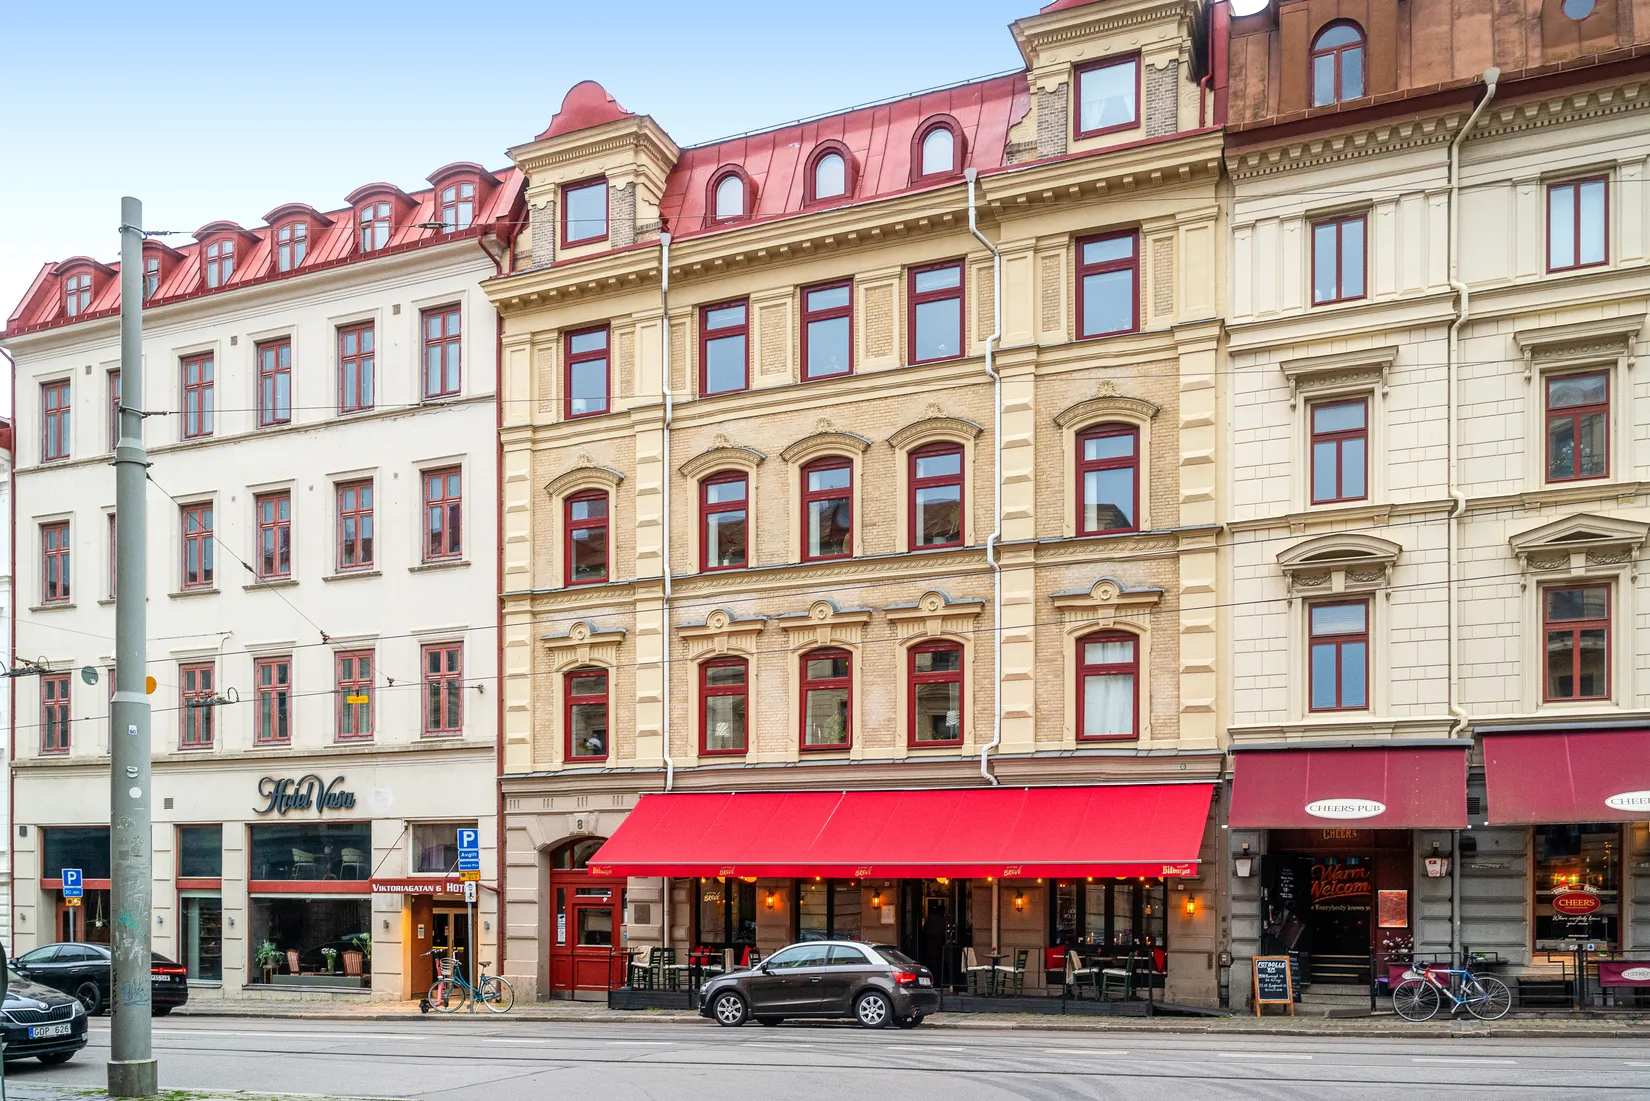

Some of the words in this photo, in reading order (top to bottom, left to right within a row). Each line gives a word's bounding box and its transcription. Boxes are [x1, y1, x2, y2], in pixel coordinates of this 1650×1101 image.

[252, 776, 312, 815] Hotel
[296, 775, 356, 813] Vasa
[1610, 797, 1650, 805] CHEE
[577, 819, 584, 830] 8
[463, 831, 475, 848] P
[67, 871, 77, 885] P
[1311, 864, 1370, 881] Warm
[1311, 880, 1371, 899] Welcom
[1315, 904, 1346, 912] Everybody
[1558, 899, 1595, 907] CHEERS
[54, 1025, 70, 1034] 626
